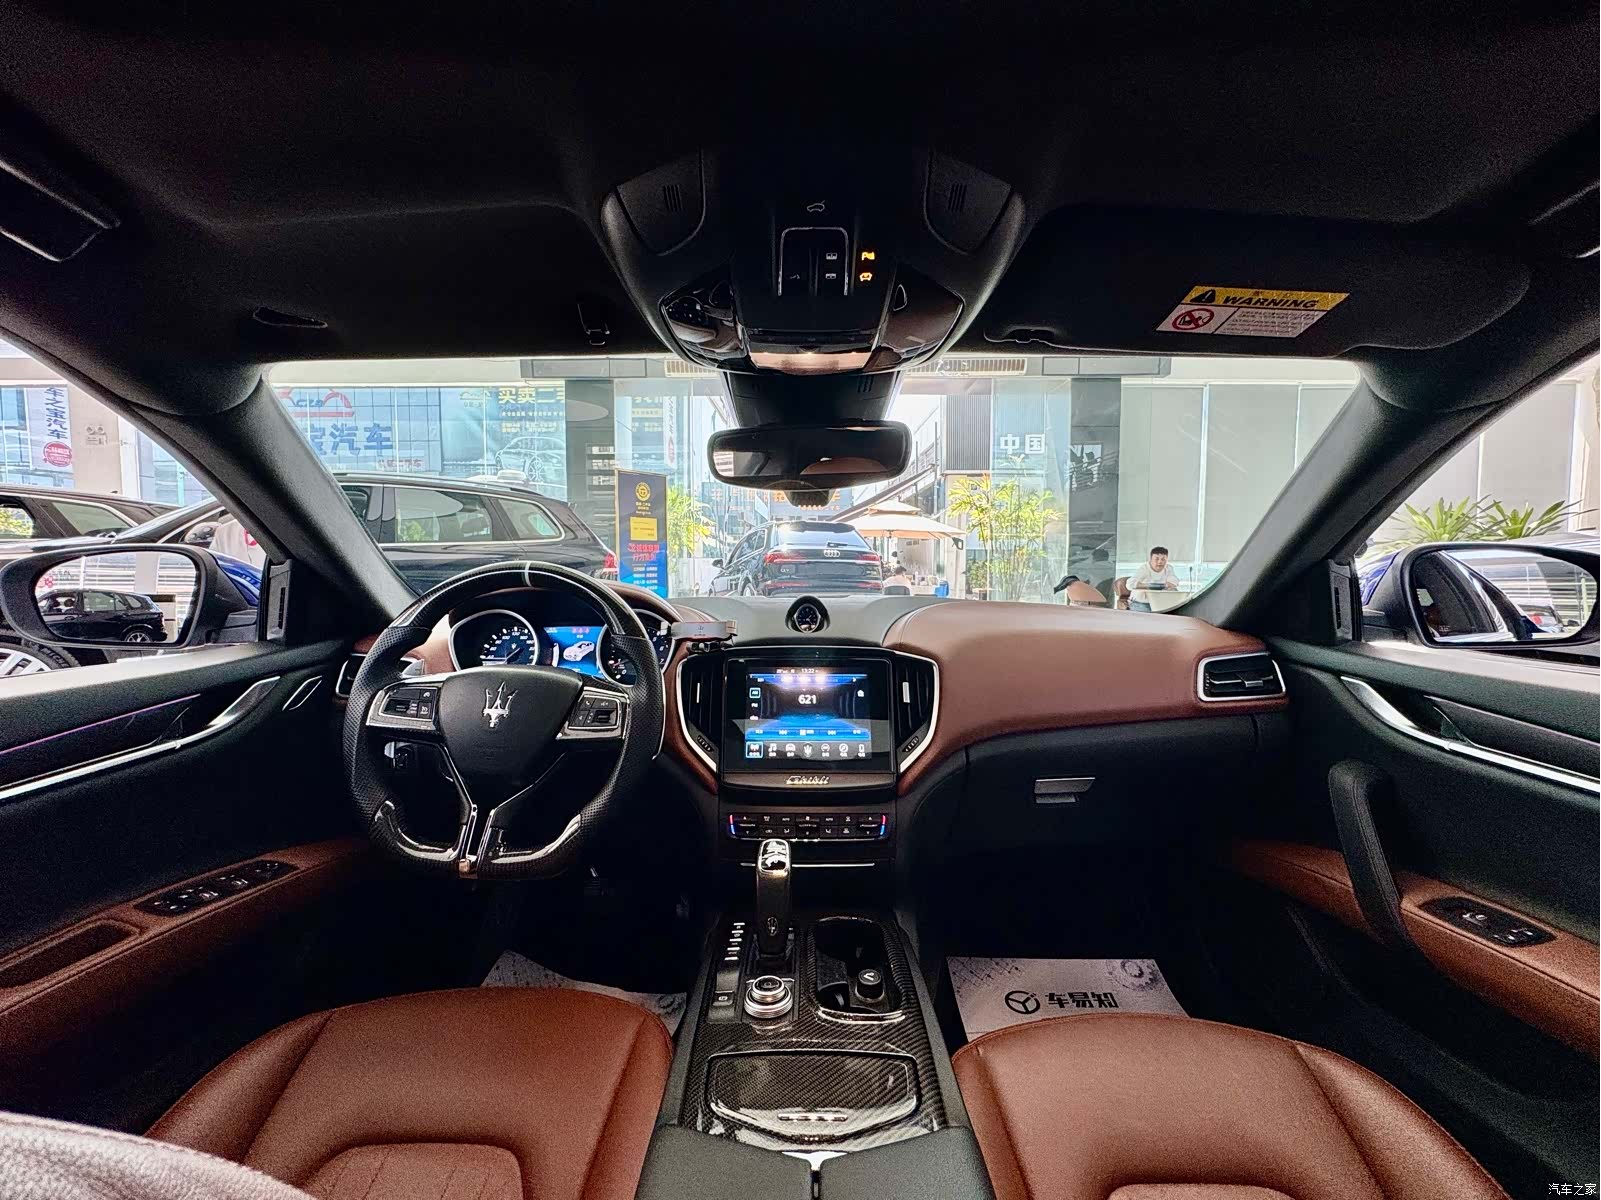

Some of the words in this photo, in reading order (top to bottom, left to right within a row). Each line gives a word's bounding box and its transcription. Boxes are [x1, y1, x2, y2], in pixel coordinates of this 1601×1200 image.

[1222, 295, 1319, 308] WARNING
[44, 387, 68, 440] 车之宝汽车
[1000, 433, 1045, 455] 中国
[798, 694, 817, 704] 621
[1044, 991, 1120, 1009] 车易知
